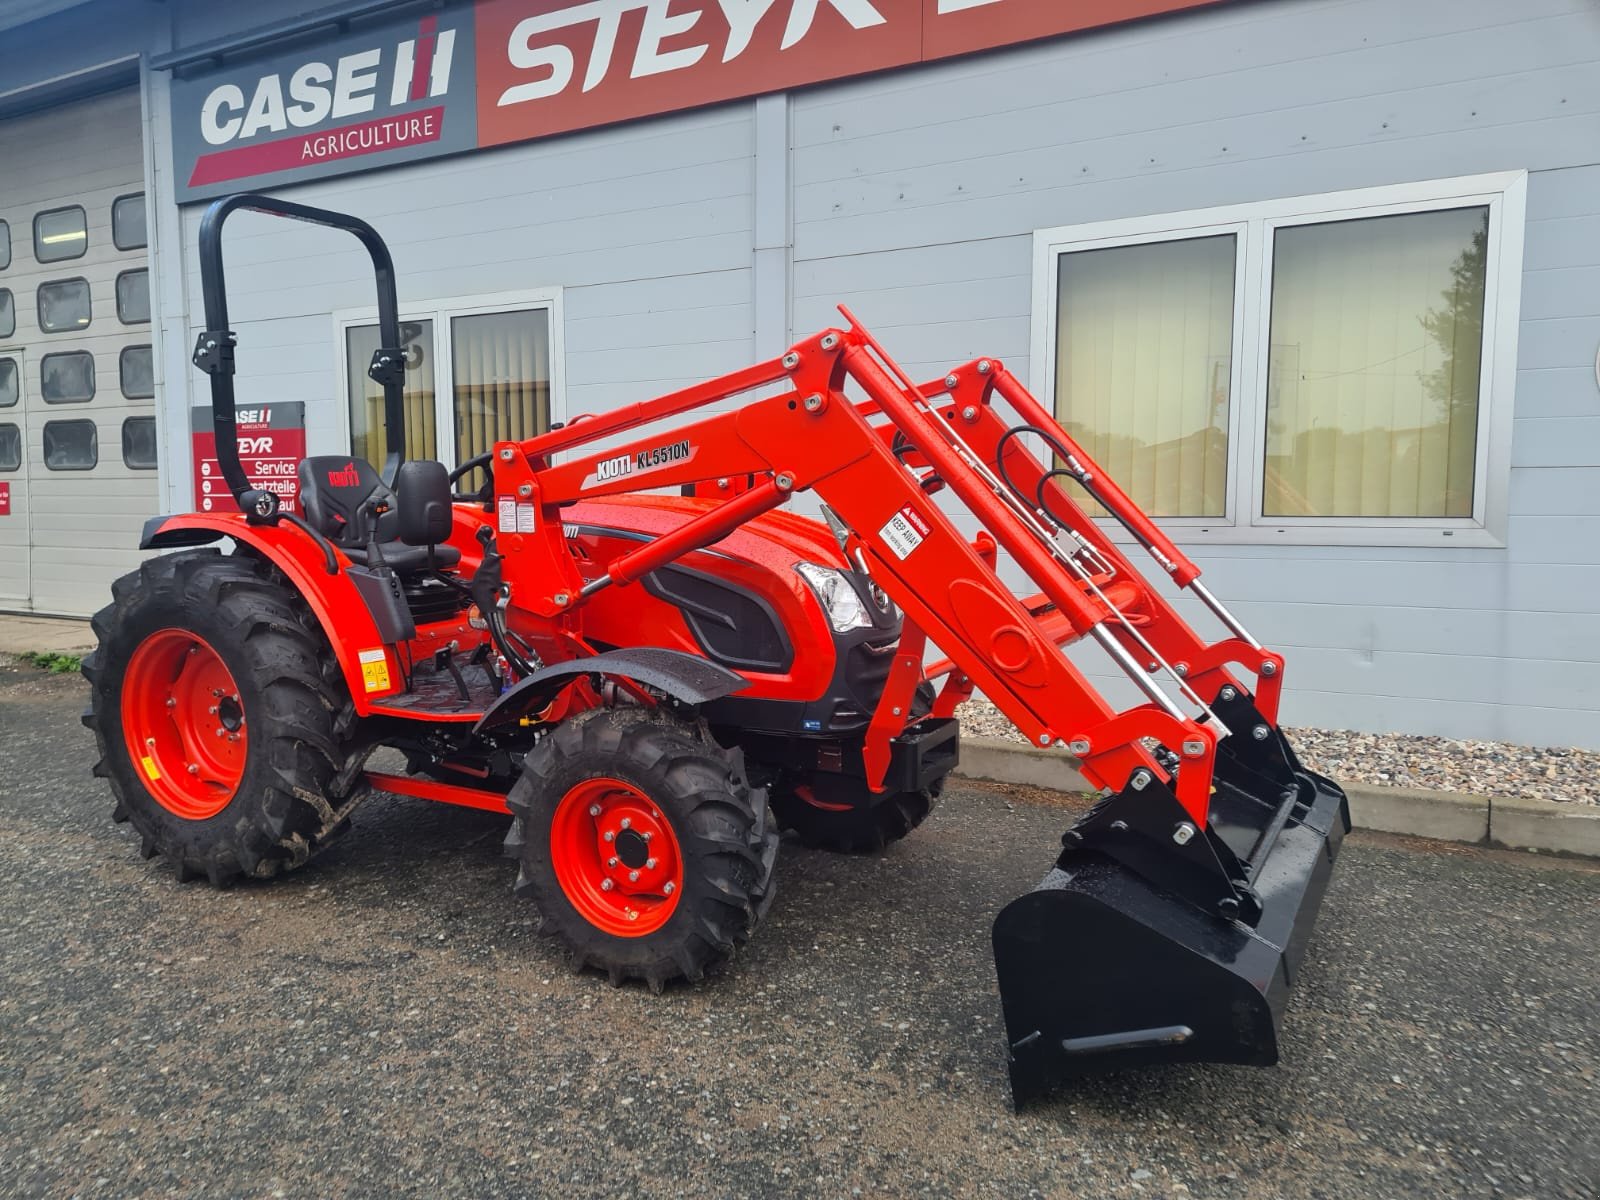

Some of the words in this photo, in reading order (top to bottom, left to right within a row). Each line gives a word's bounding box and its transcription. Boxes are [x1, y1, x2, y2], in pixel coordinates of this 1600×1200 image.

[200, 48, 382, 145] CASE
[301, 115, 434, 160] AGRICULTURE
[255, 461, 295, 475] Service
[597, 454, 632, 481] KIOTI
[637, 440, 690, 469] KL5510N
[891, 516, 906, 531] KEEP
[901, 530, 919, 547] AWAY
